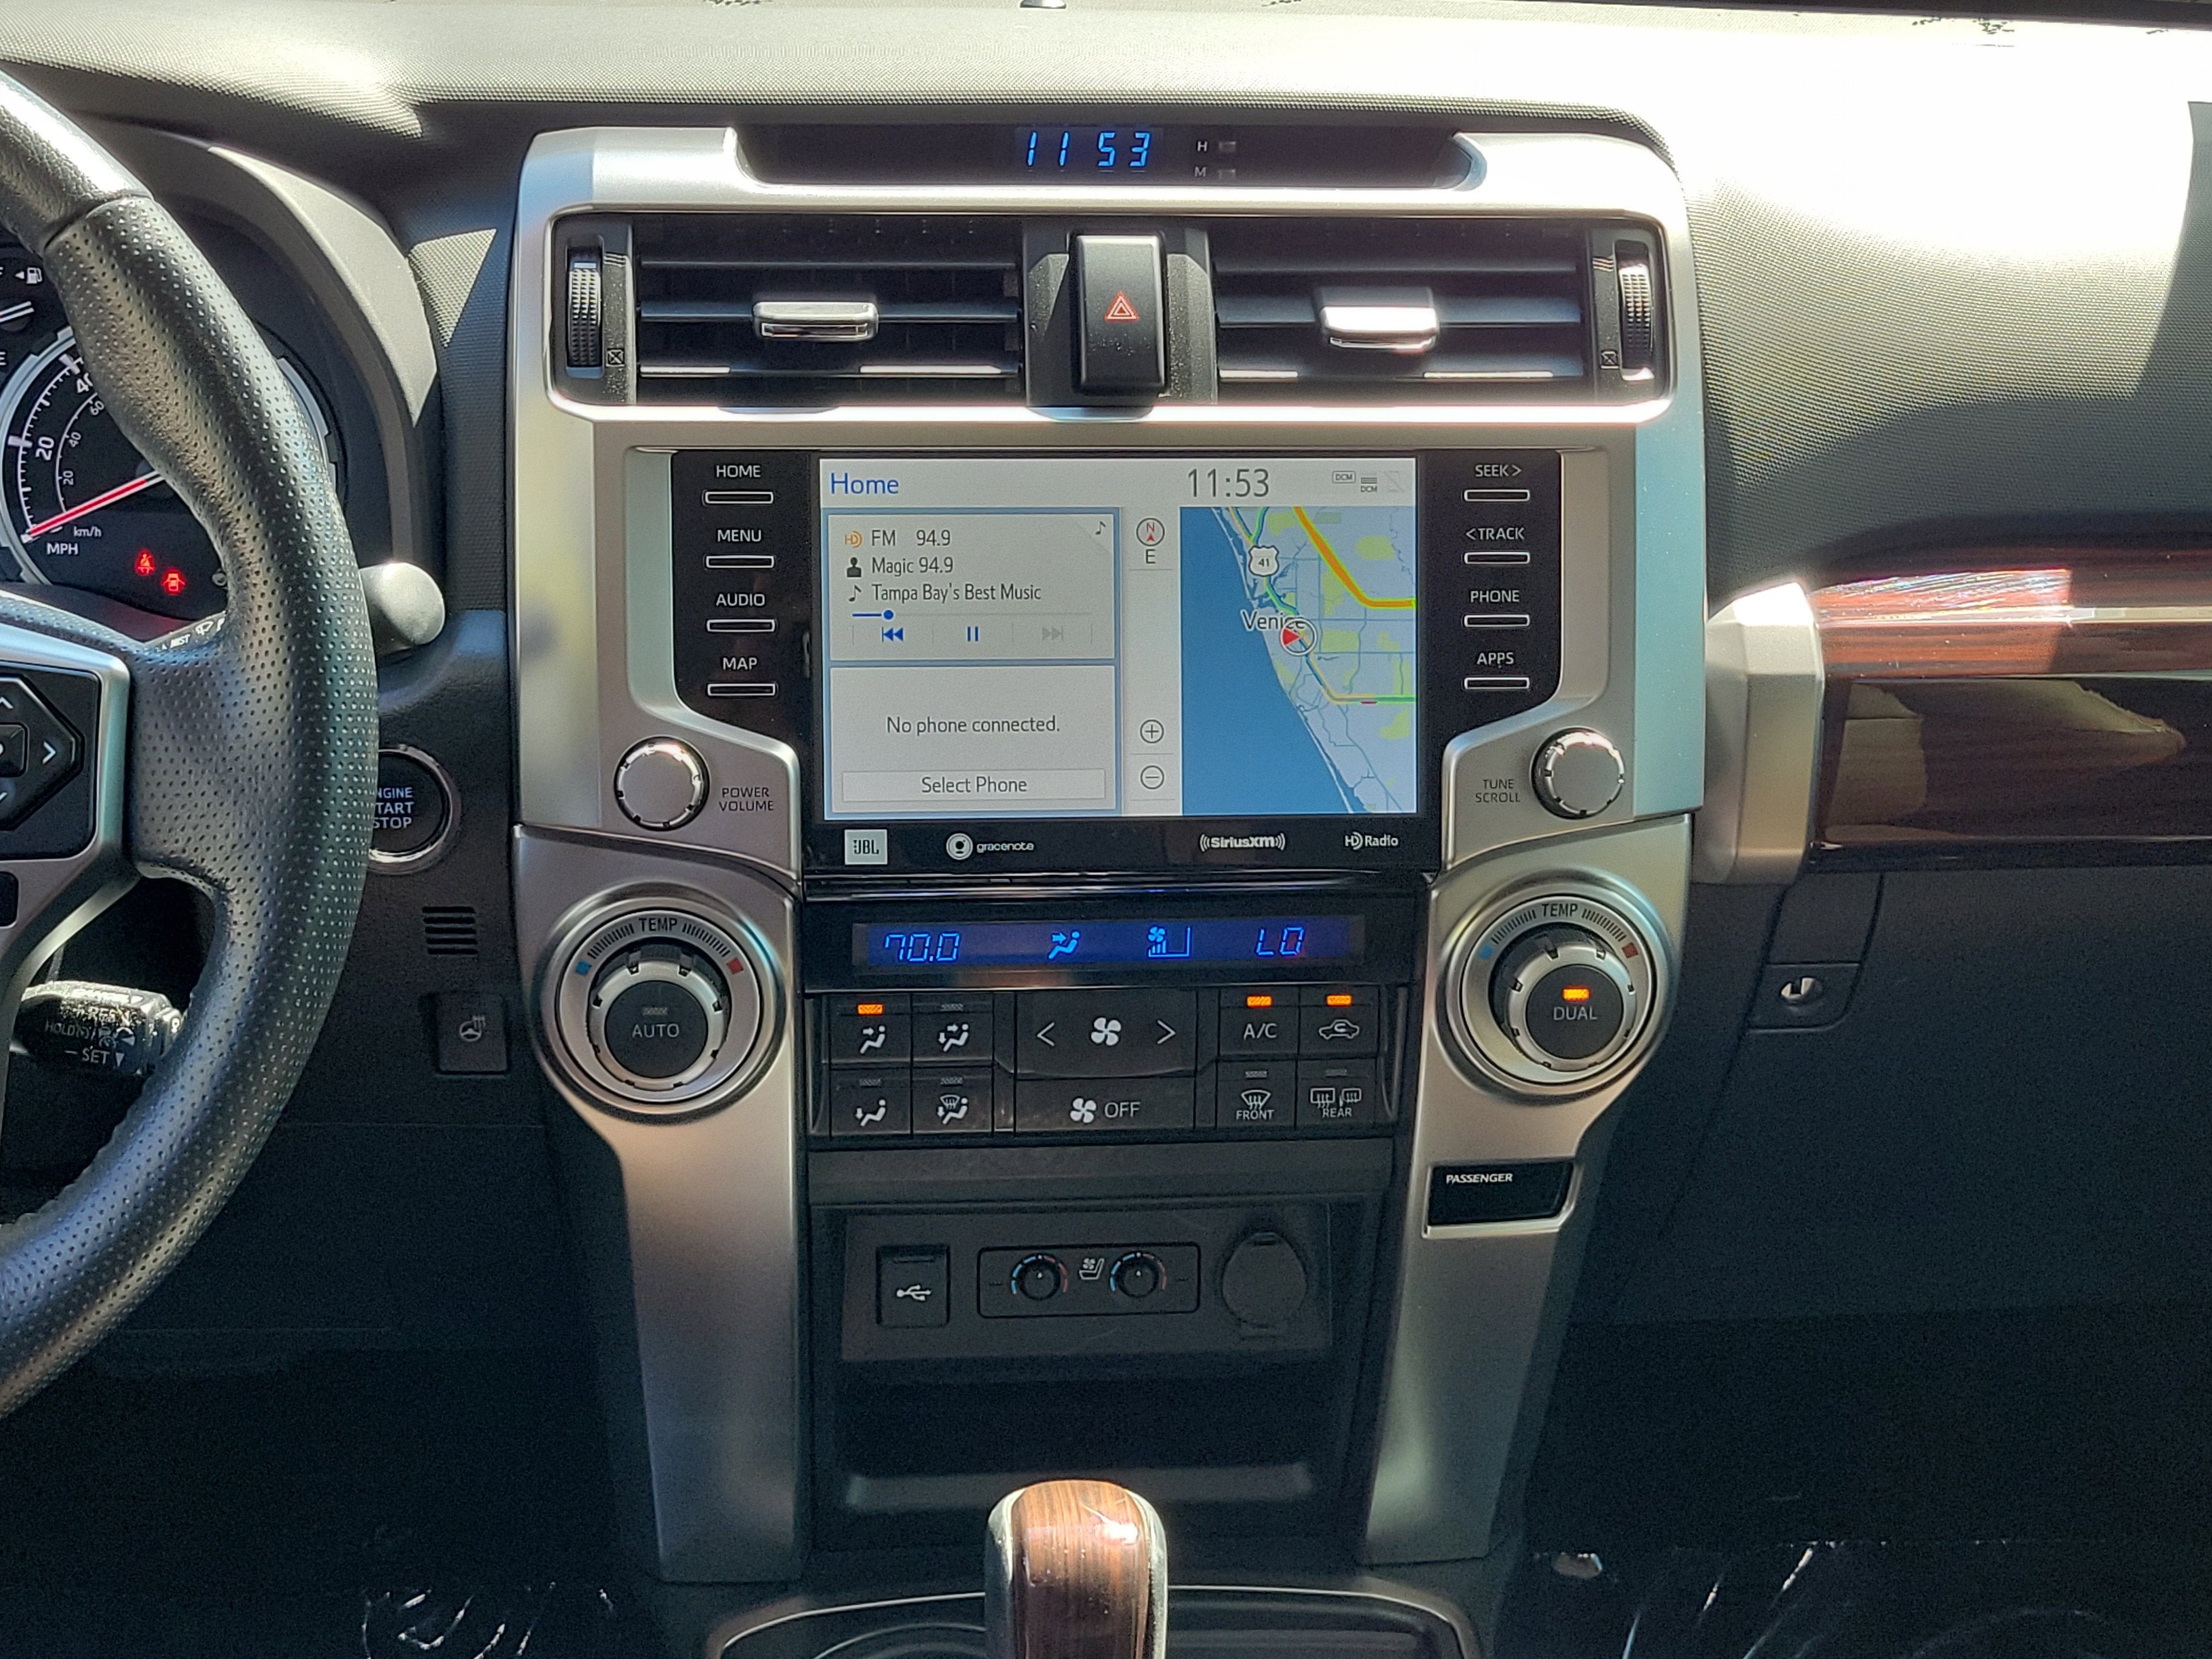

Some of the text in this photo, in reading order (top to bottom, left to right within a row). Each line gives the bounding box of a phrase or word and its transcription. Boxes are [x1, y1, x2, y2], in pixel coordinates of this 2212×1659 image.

[1197, 141, 1207, 152] H
[1194, 167, 1207, 178] M
[90, 400, 105, 415] 60
[68, 432, 82, 447] 40
[35, 436, 54, 460] 20
[63, 470, 74, 485] 20
[716, 465, 761, 478] HOME
[831, 473, 899, 494] Home
[1188, 469, 1269, 497] 11:53
[73, 526, 102, 537] km/h
[1146, 523, 1155, 532] N
[717, 529, 762, 542] MENU
[871, 529, 951, 546] FM 94.9
[47, 542, 79, 555] MPH
[1146, 549, 1155, 563] E
[1259, 557, 1270, 567] 41
[871, 556, 953, 577] Magic 94.9
[871, 583, 1041, 603] Tampa Bay's Best Music
[1470, 590, 1520, 602] PHONE
[715, 594, 765, 606] AUDIO
[722, 657, 758, 670] MAP
[1476, 652, 1514, 665] APPS
[887, 715, 1060, 736] No phone connected.
[922, 776, 1028, 793] Select Phone
[1482, 778, 1514, 789] TUNE
[721, 787, 769, 798] POWER
[1475, 792, 1520, 803] SCROLL
[375, 802, 415, 815] TART
[719, 800, 774, 811] VOLUME
[854, 839, 879, 855] JBL
[1364, 834, 1398, 847] Radio
[977, 842, 1035, 854] gracenote
[1542, 903, 1578, 917] TEMP
[638, 917, 678, 932] TEMP
[884, 933, 961, 962] 70.0
[1553, 1007, 1598, 1020] DUAL
[631, 1023, 680, 1037] AUTO
[1243, 1023, 1277, 1040] A/C
[1104, 1102, 1141, 1119] OFF
[1236, 1109, 1275, 1120] FRONT
[1322, 1107, 1352, 1119] REAR
[1446, 1172, 1513, 1184] PASSENGER
